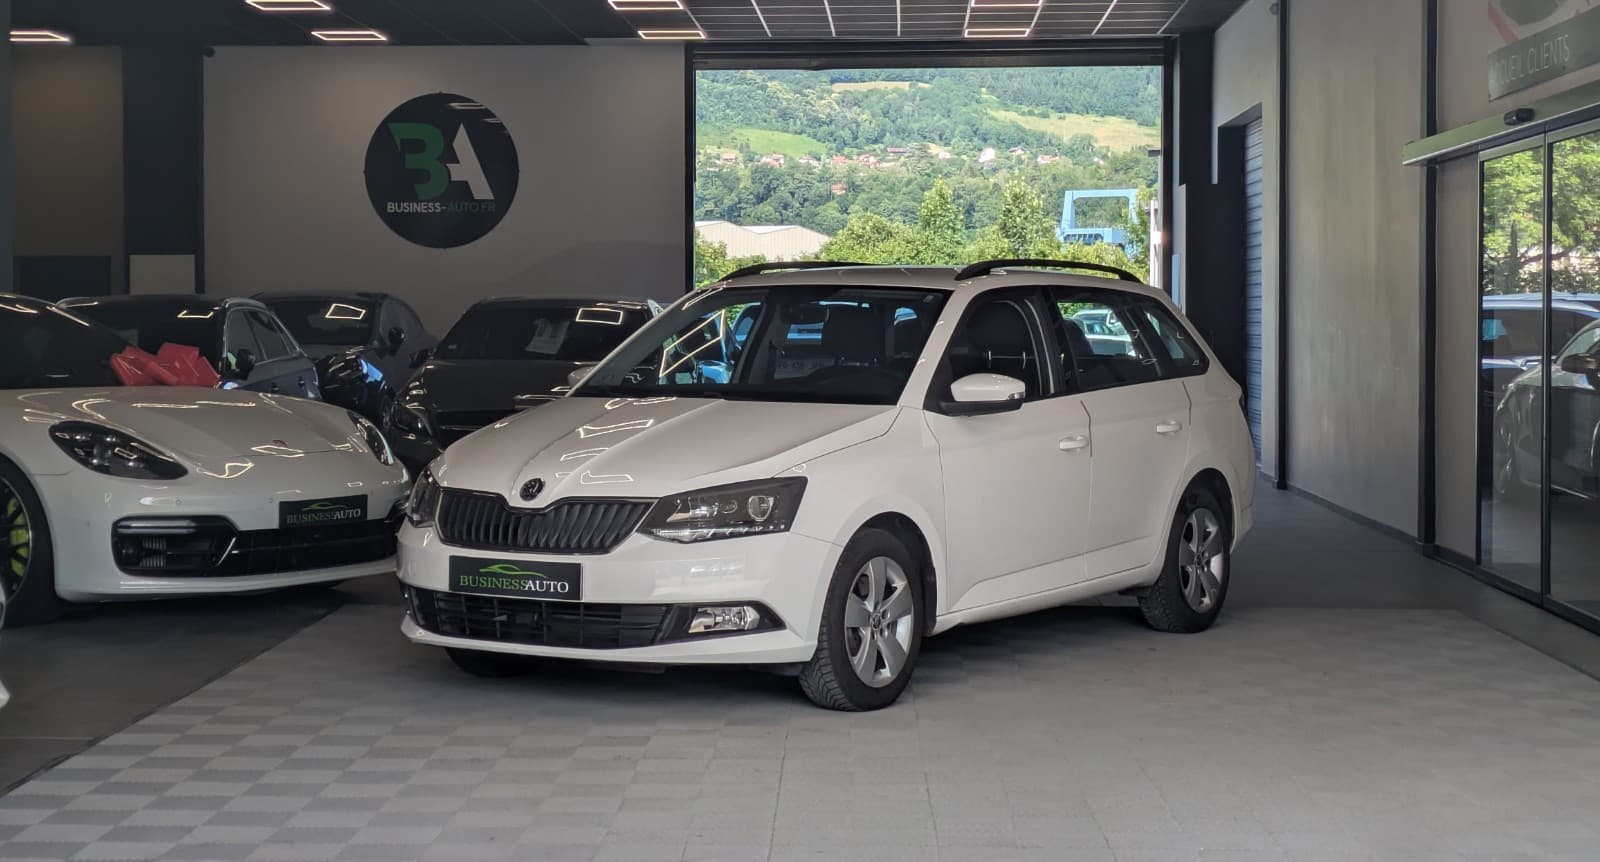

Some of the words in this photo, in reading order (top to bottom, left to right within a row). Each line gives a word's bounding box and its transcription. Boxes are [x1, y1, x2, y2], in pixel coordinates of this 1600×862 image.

[1527, 34, 1570, 74] CLIENTS
[387, 122, 495, 200] BA
[387, 202, 496, 213] BUSINESS-AUTOFR
